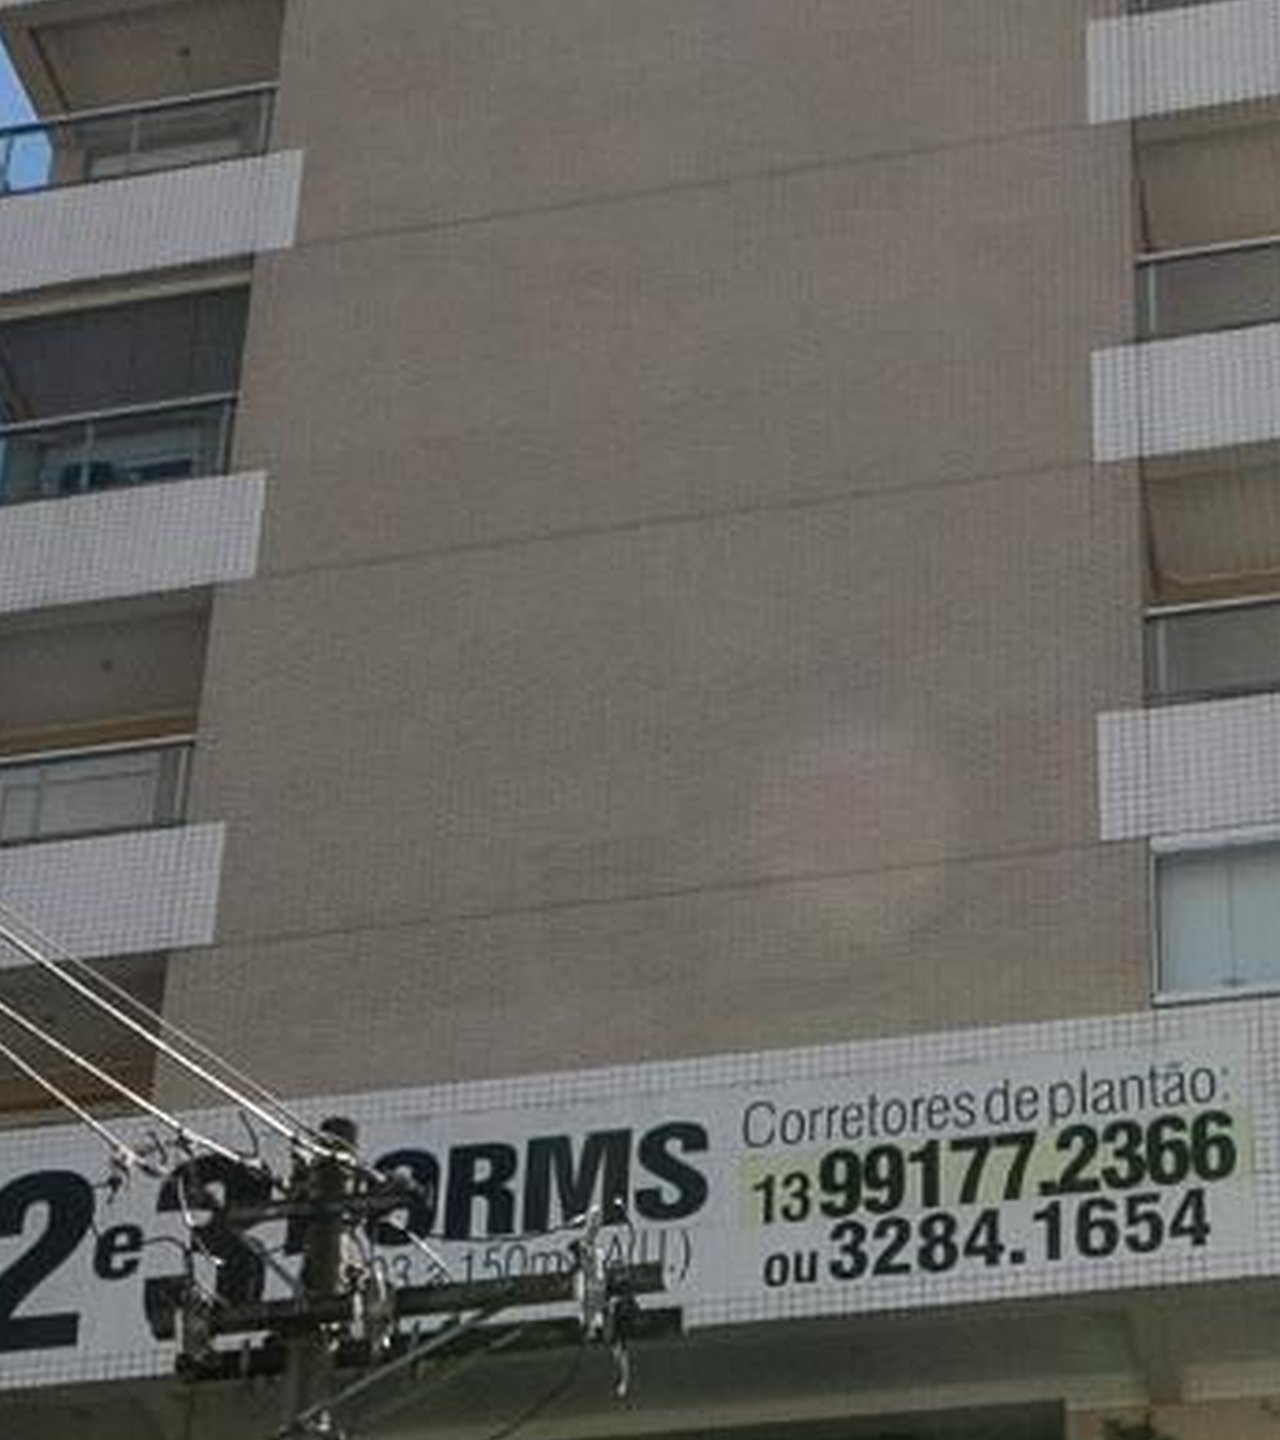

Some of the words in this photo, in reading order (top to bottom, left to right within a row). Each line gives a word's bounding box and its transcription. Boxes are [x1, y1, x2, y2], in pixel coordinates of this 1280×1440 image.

[741, 1088, 976, 1149] Corretores
[984, 1079, 1040, 1125] de
[1048, 1062, 1231, 1126] plantão:
[92, 1223, 145, 1280] e
[282, 1120, 711, 1255] ORMS
[753, 1170, 812, 1224] 13
[820, 1109, 1238, 1220] 99177.2366
[764, 1248, 817, 1288] ou
[828, 1188, 1210, 1281] 3284.1654
